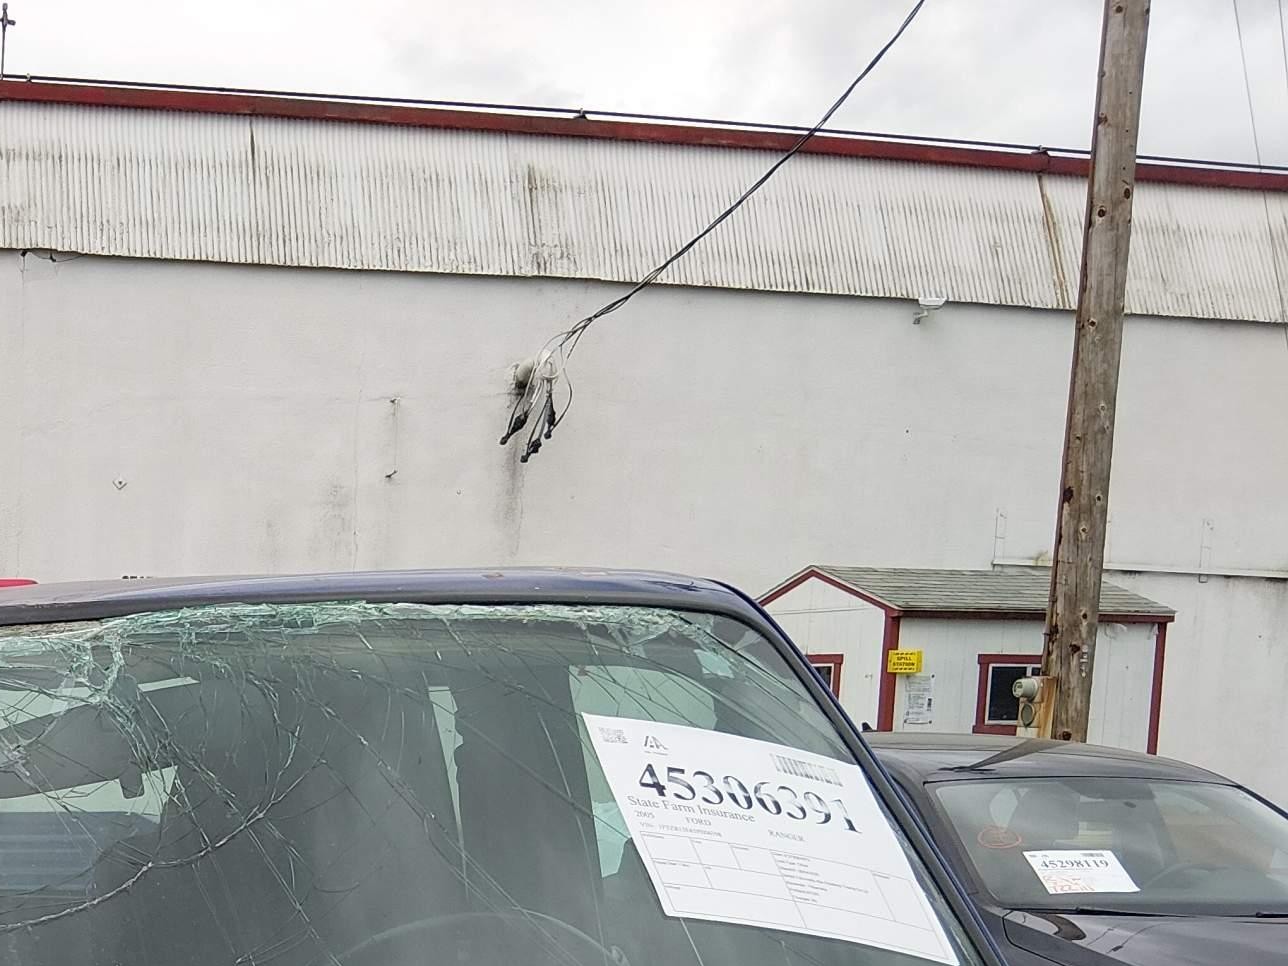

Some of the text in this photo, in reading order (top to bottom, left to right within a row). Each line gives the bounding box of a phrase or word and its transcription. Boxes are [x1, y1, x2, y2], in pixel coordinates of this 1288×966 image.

[639, 763, 863, 834] 45306391
[627, 795, 756, 822] State Farm Insurance
[685, 816, 712, 827] FORD
[1040, 859, 1110, 869] 45298119
